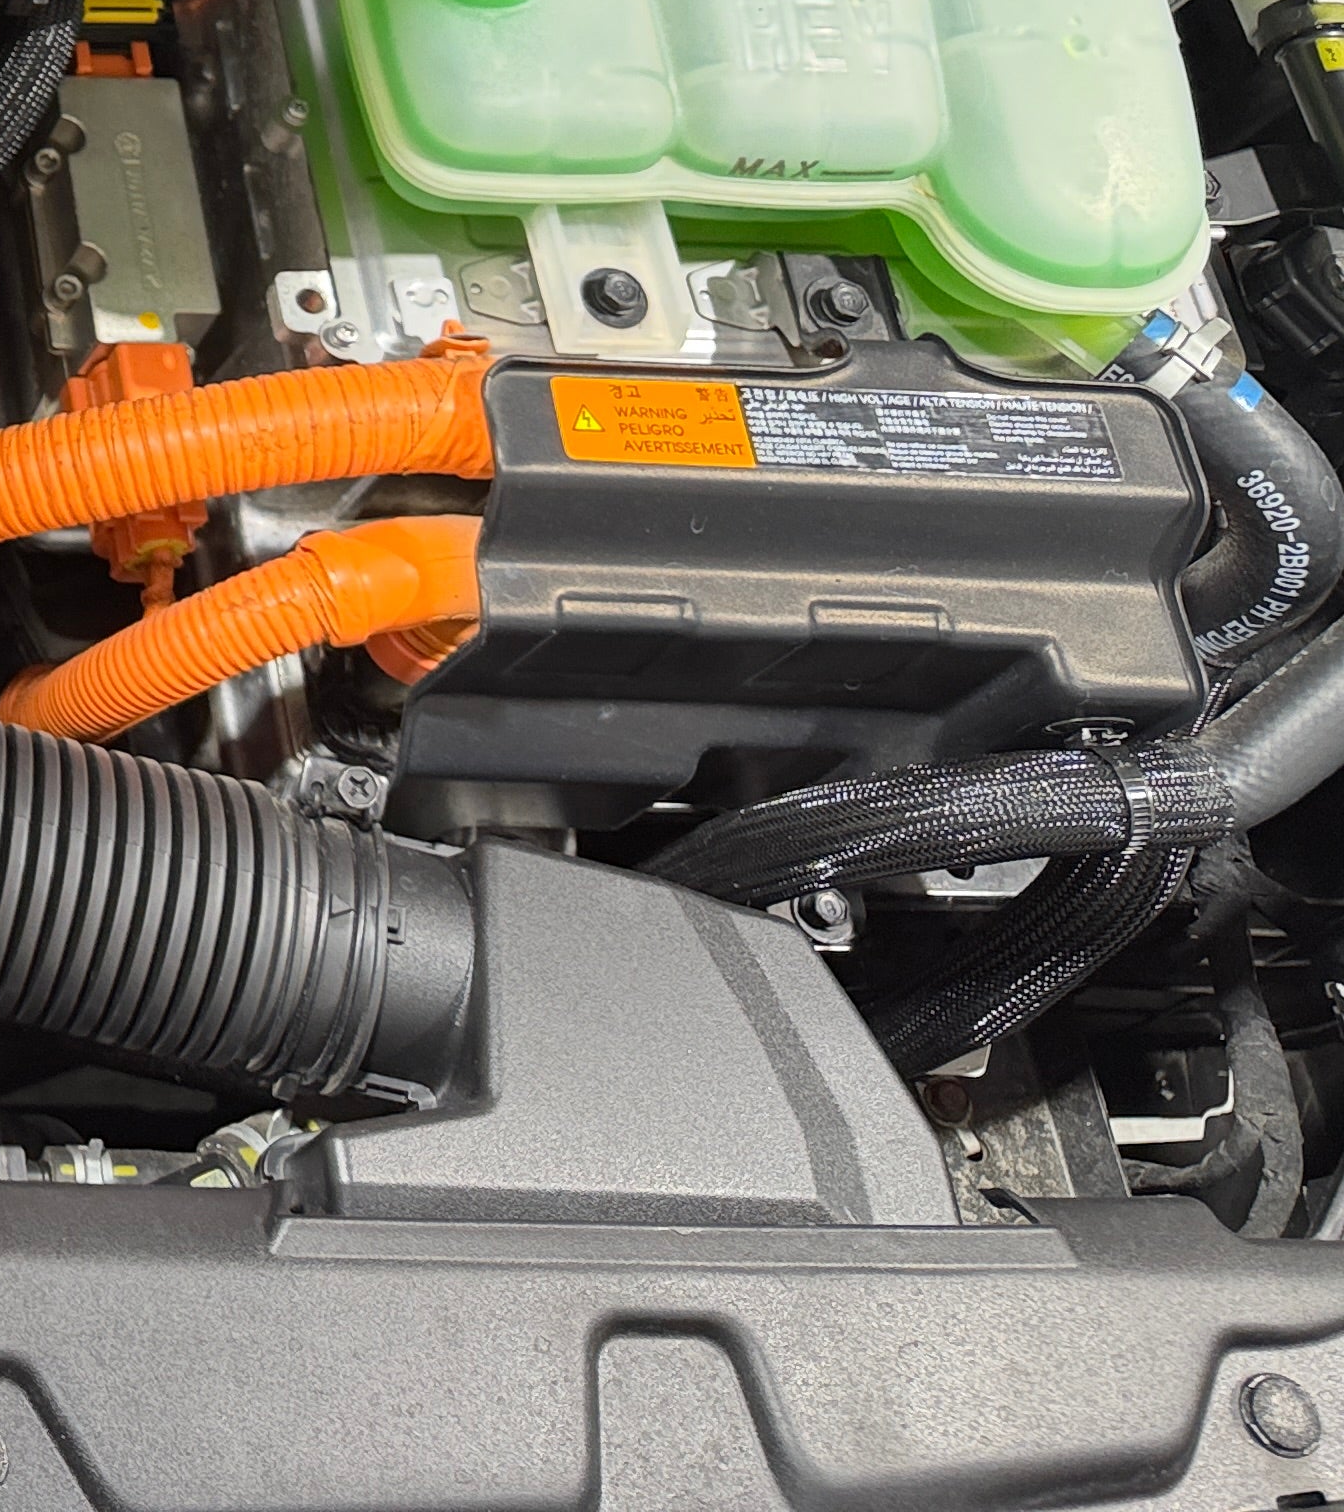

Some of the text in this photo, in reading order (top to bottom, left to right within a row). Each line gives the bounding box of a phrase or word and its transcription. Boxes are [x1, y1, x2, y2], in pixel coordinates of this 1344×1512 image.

[728, 157, 819, 178] MAX
[609, 384, 641, 399] 경고
[827, 391, 858, 403] HIGH
[857, 393, 911, 406] VOLTAGE
[917, 395, 948, 407] ALTA
[946, 397, 996, 409] TENSION
[1038, 401, 1087, 413] TENSION
[614, 406, 687, 420] WARNING
[619, 423, 684, 436] PELIGRO
[624, 440, 744, 456] AVERTISSEMENT
[1237, 469, 1310, 598] 36920-2B001
[1251, 599, 1292, 626] PH
